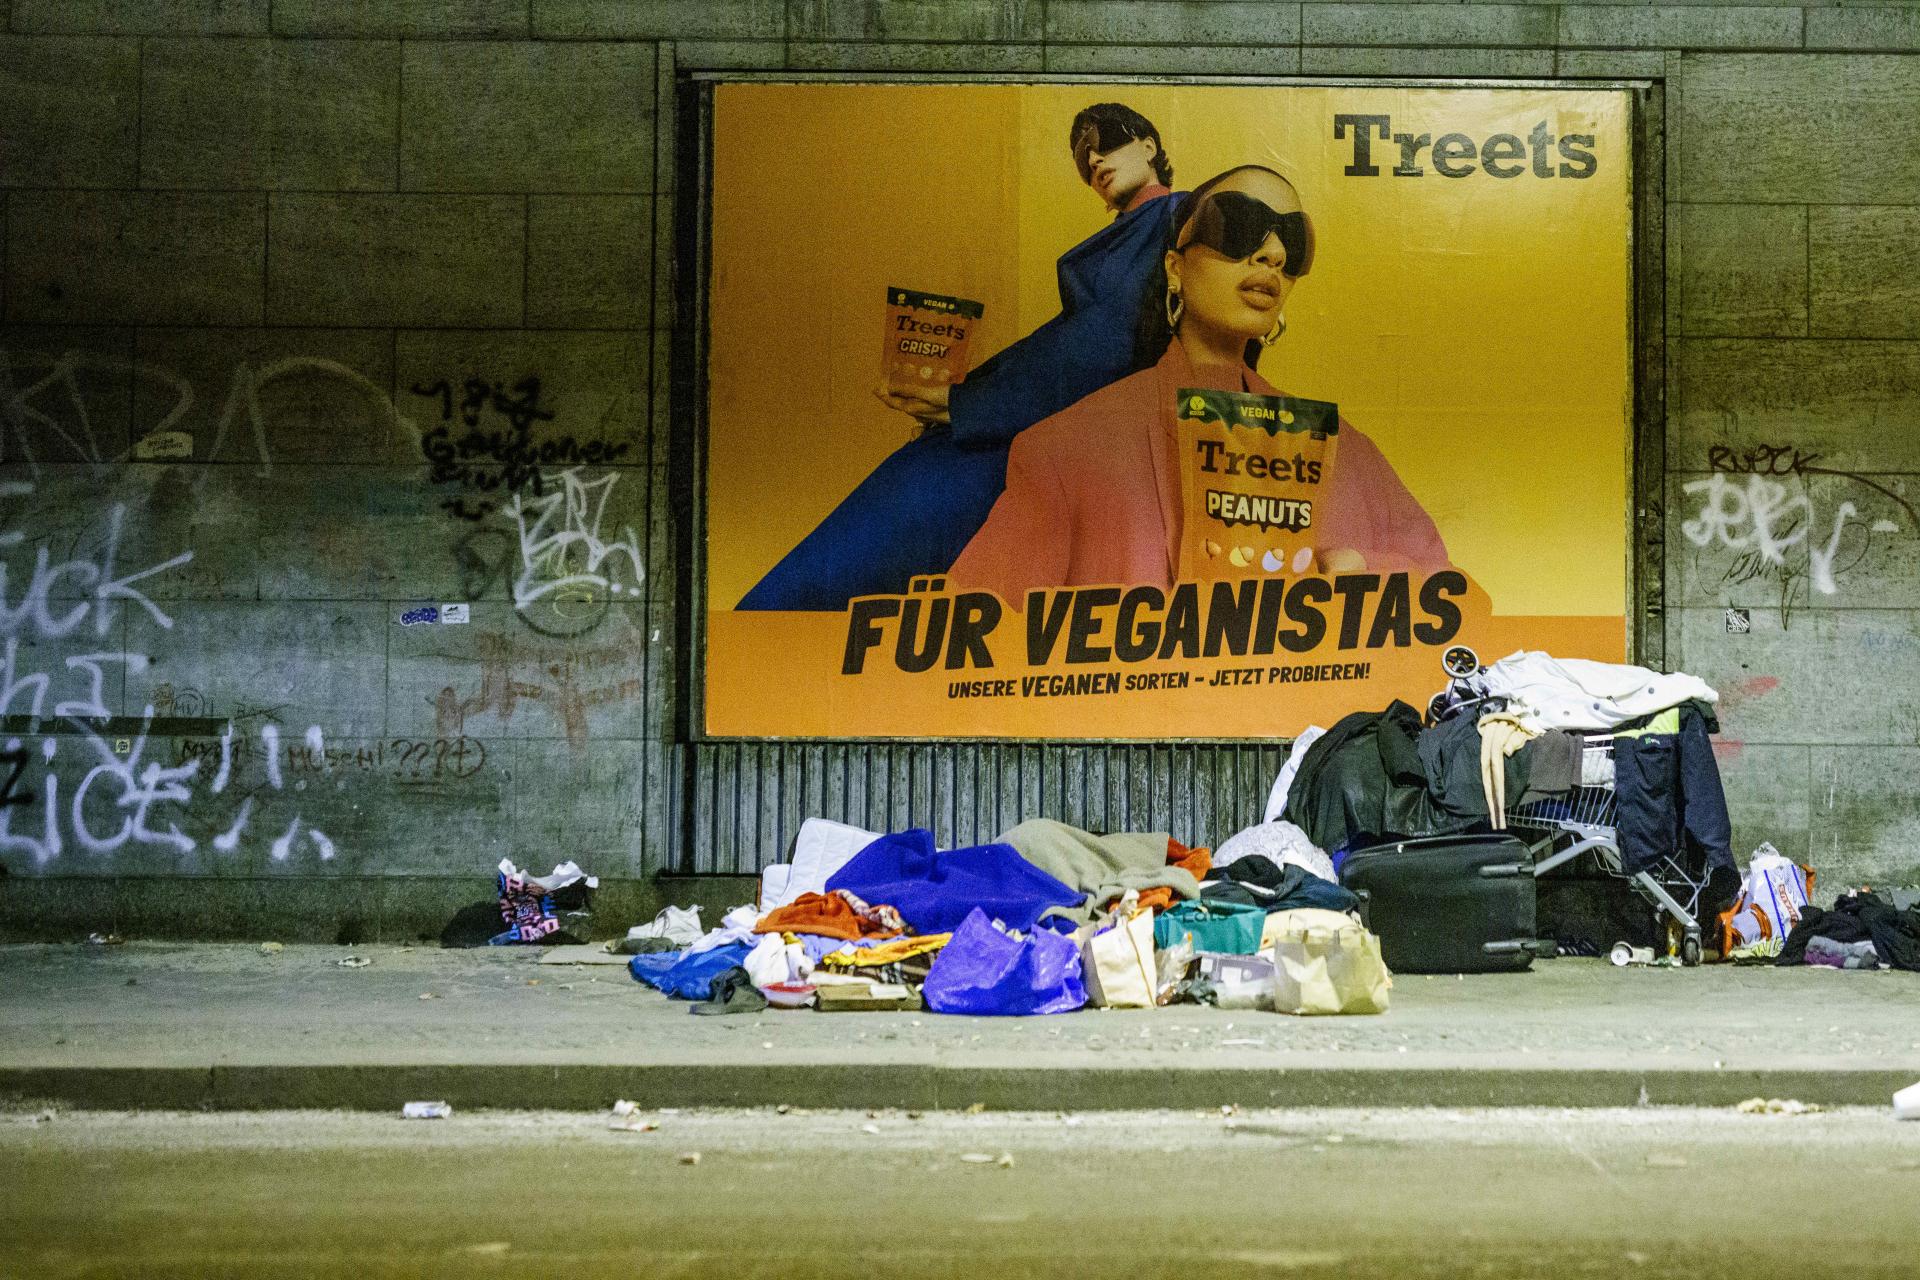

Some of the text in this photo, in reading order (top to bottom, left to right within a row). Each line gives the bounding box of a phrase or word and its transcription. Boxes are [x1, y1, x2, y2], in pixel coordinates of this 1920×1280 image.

[1334, 114, 1598, 179] Treets
[923, 299, 947, 309] VEGAN
[896, 315, 966, 341] Treets
[900, 339, 948, 358] CRISPY
[1240, 406, 1275, 421] VEGAN
[1197, 440, 1323, 485] Treets
[1206, 490, 1313, 528] PEANUTS
[842, 570, 1468, 675] FÜR VEGANISTAS
[948, 680, 1017, 699] UNSERE
[1022, 672, 1121, 698] VEGANEN
[1125, 671, 1190, 691] SORTEN
[1209, 668, 1265, 687] JETZT
[1268, 663, 1371, 683] PROBIEREN!
